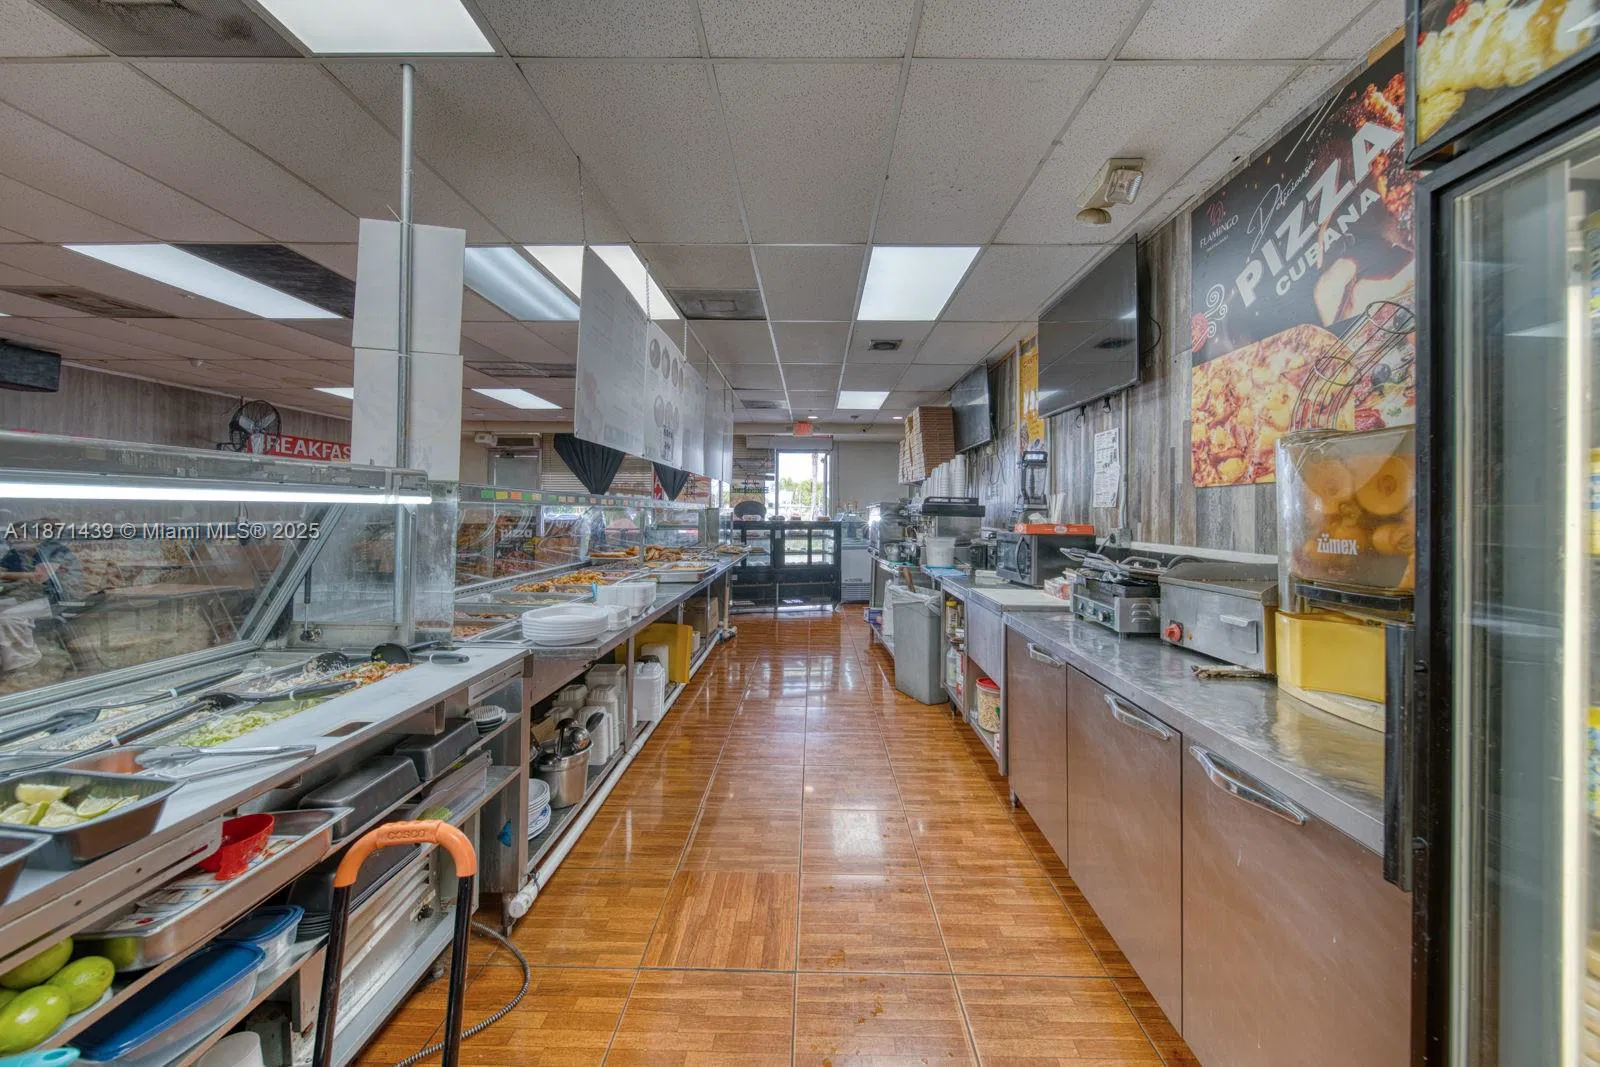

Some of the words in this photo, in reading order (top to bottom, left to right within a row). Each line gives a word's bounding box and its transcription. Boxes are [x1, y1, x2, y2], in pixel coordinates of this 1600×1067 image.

[1200, 214, 1239, 248] FLAMINGO
[1235, 121, 1400, 308] PIZZA
[1276, 188, 1381, 296] CUBANA
